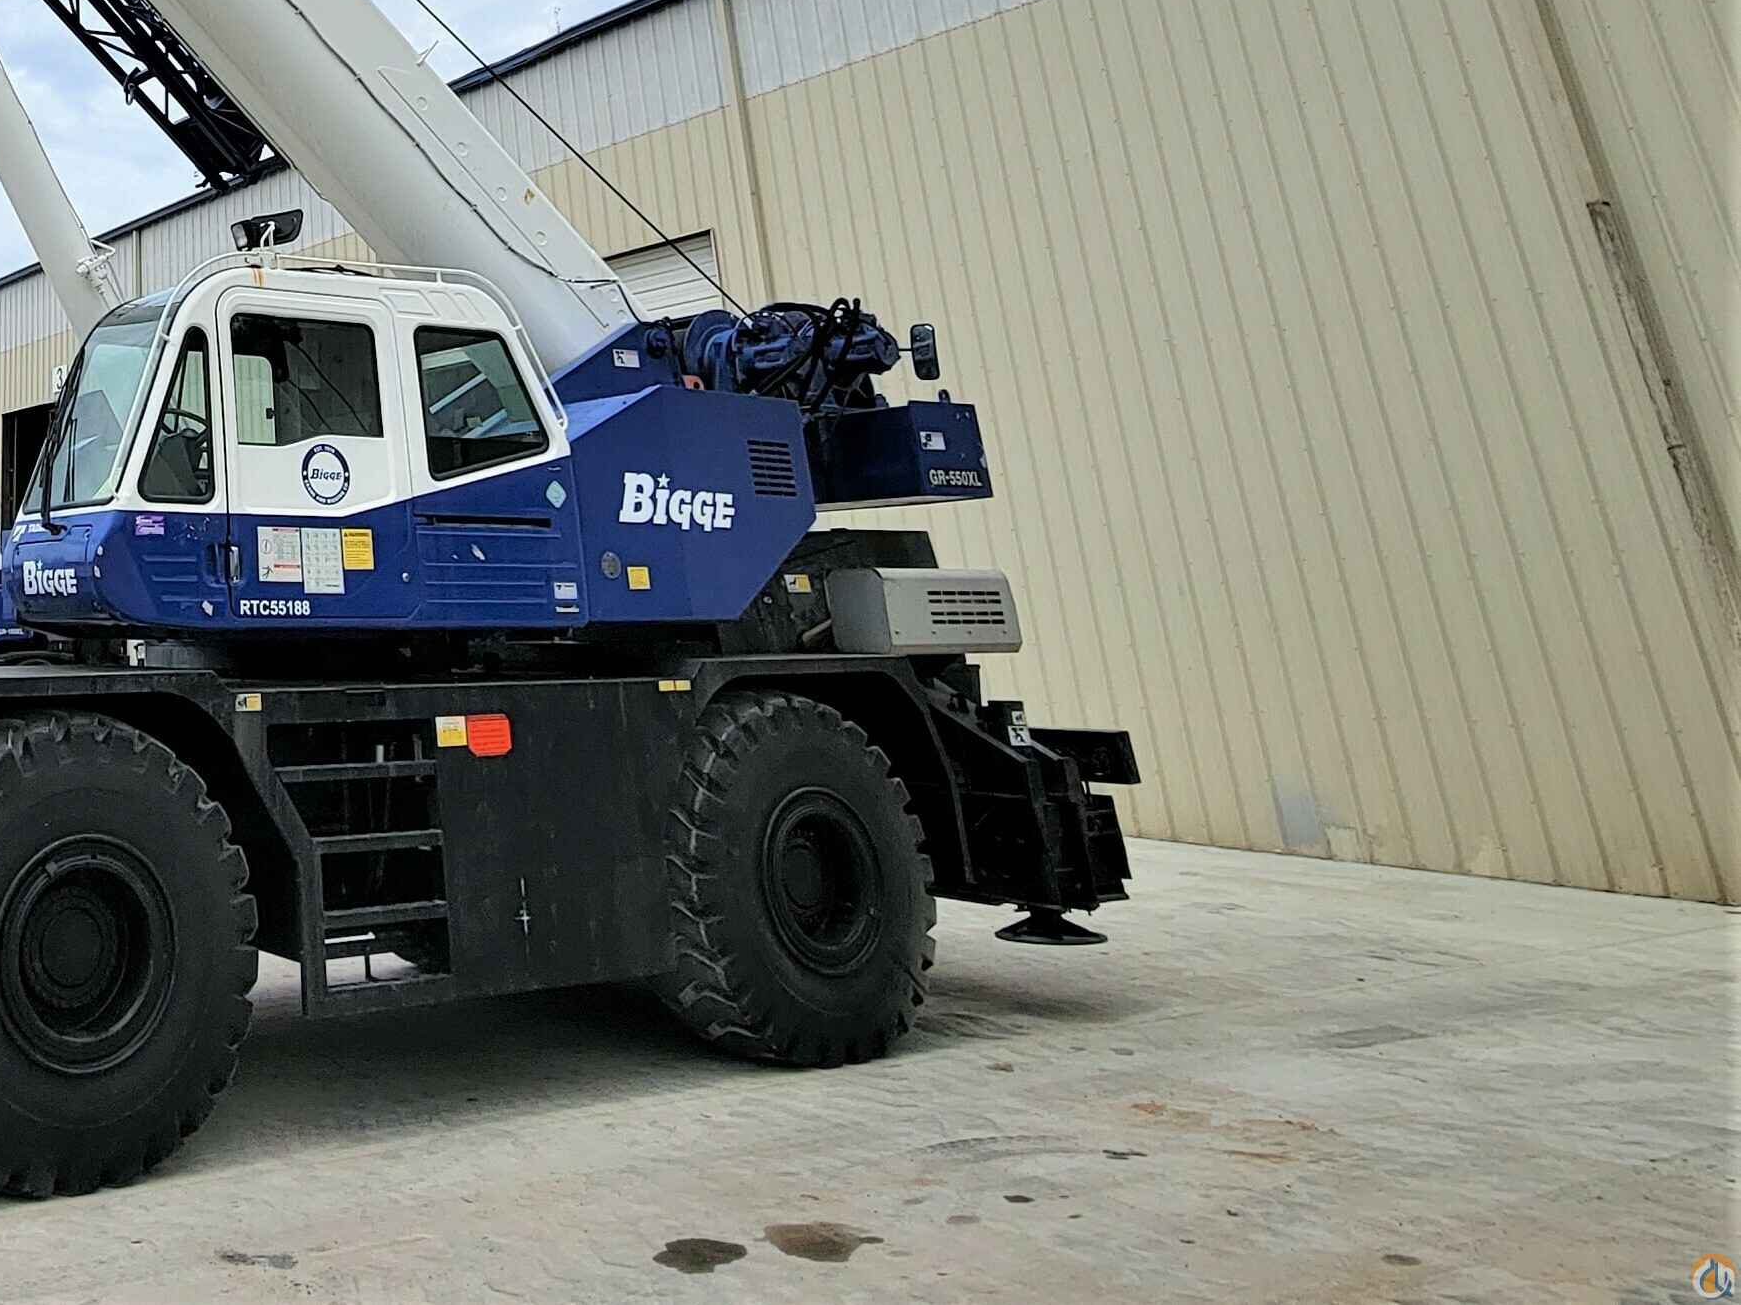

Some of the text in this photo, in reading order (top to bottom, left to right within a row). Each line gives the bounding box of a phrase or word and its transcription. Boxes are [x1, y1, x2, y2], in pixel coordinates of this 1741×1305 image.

[56, 367, 63, 390] 3
[929, 469, 983, 487] GR-550XL
[240, 599, 311, 615] RTC55188
